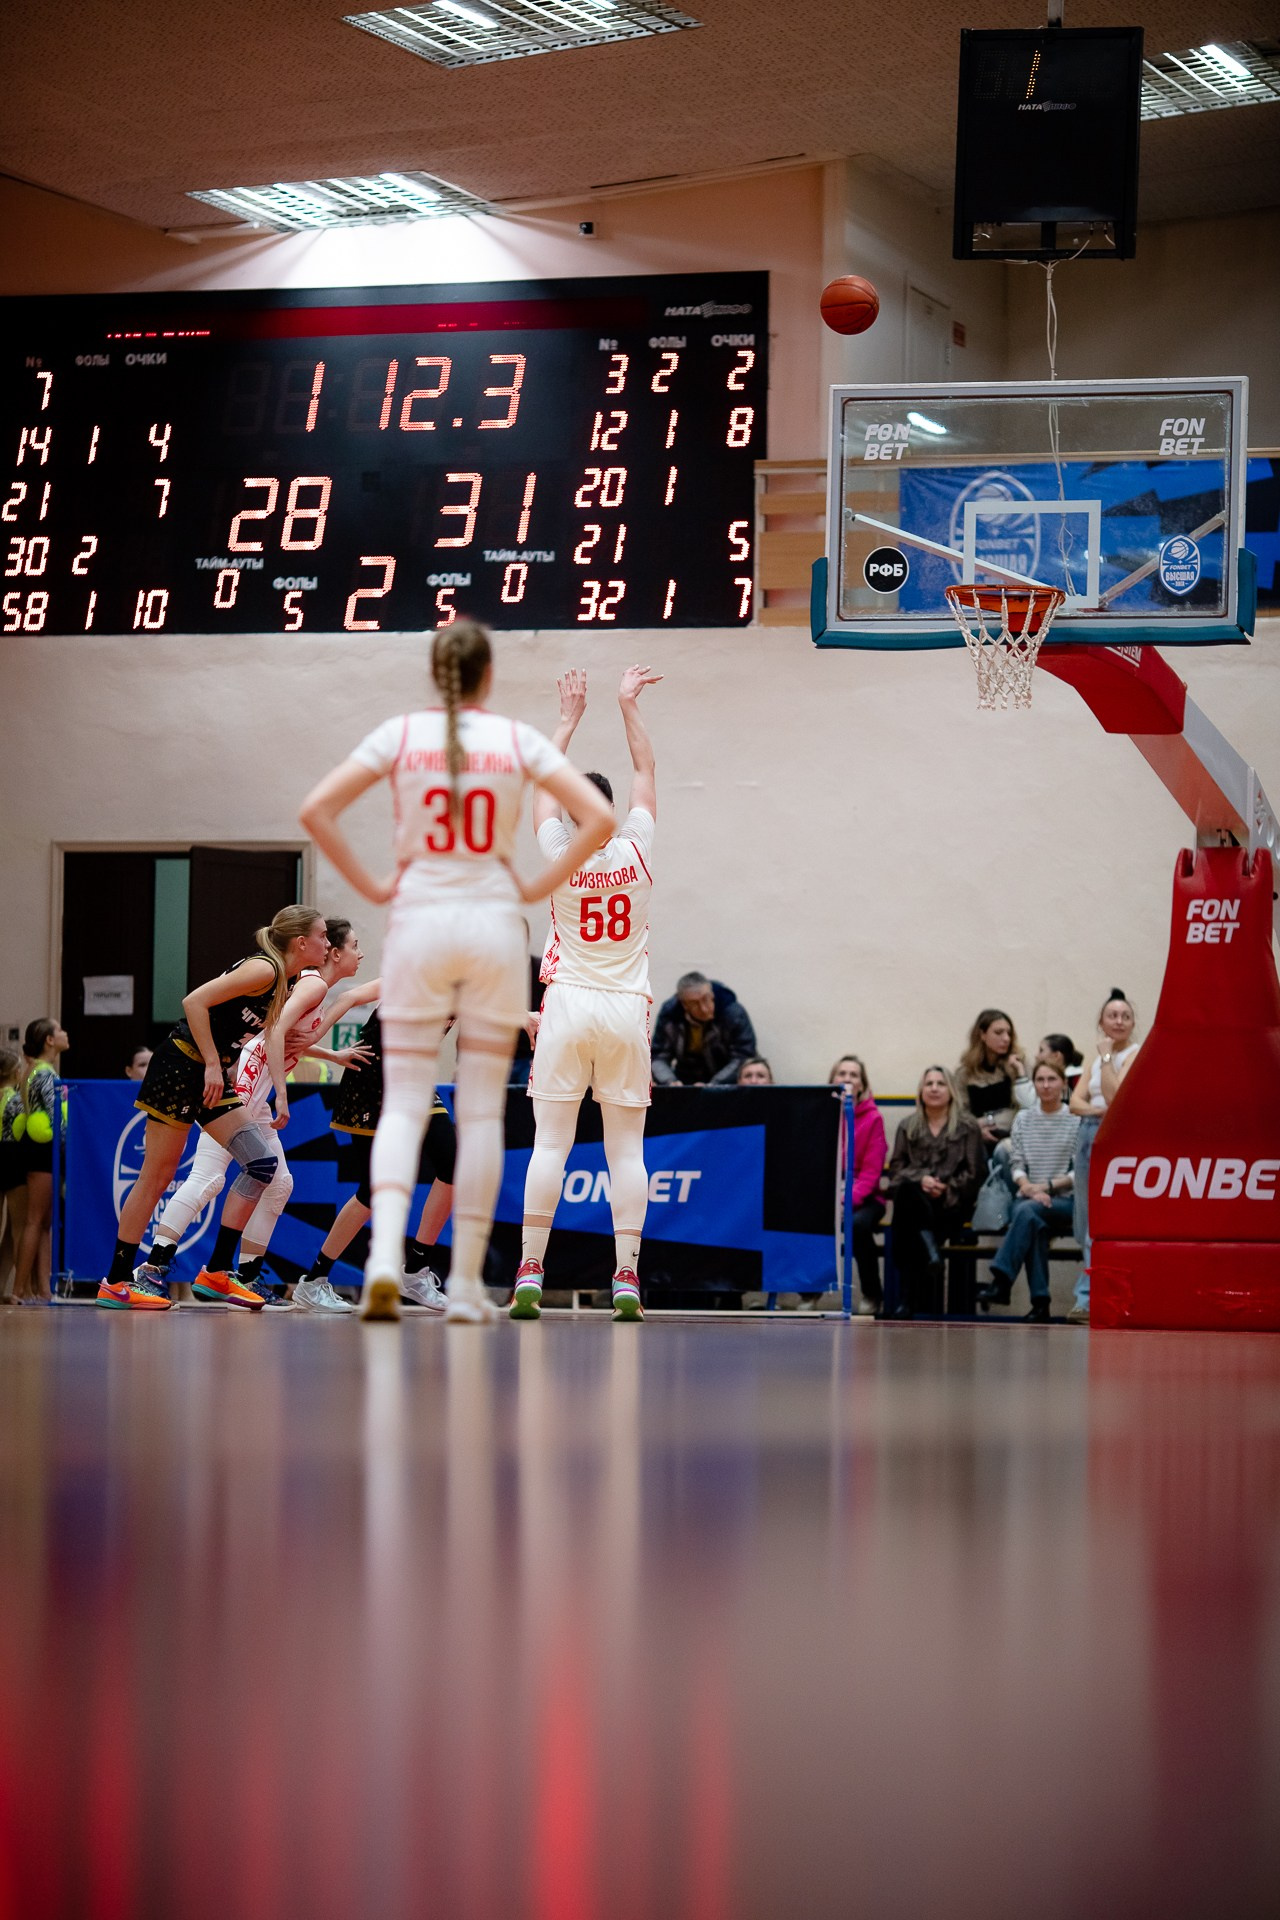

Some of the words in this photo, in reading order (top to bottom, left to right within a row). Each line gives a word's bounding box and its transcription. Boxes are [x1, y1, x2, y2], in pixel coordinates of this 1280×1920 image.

[75, 354, 110, 366] ФОЛЫ
[125, 352, 167, 365] ОЧКИ
[649, 336, 686, 348] ФОЛЫ
[711, 334, 755, 347] ОЧКИ
[36, 371, 53, 411] 7
[378, 353, 527, 432] 12.3
[605, 354, 630, 394] 3
[650, 352, 680, 393] 2
[727, 350, 756, 391] 2
[305, 361, 326, 433] 1
[16, 426, 53, 467] 14
[87, 425, 101, 465] 1
[148, 423, 172, 463] 4
[589, 410, 629, 452] 12
[665, 409, 679, 449] 1
[725, 406, 755, 448] 8
[864, 423, 911, 441] FON
[1158, 437, 1206, 456] BET
[1159, 417, 1206, 436] FON
[863, 442, 909, 460] BET
[1, 481, 51, 522] 21
[154, 478, 172, 518] 7
[573, 467, 628, 509] 20
[664, 465, 678, 506] 1
[227, 475, 333, 553] 28
[433, 471, 537, 548] 31
[4, 536, 51, 577] 30
[71, 535, 99, 576] 2
[483, 550, 555, 563] ТАЙМ-АУТЫ
[572, 523, 627, 565] 21
[727, 520, 751, 562] 5
[195, 557, 264, 570] ТАЙМ-АУТЫ
[273, 576, 318, 590] ФОЛЫ
[426, 573, 471, 587] ФОЛЫ
[500, 562, 529, 604] 0
[869, 562, 904, 578] РФБ
[213, 567, 241, 609] 0
[343, 555, 397, 631] 2
[435, 588, 457, 628] 5
[576, 580, 627, 622] 32
[662, 579, 677, 620] 1
[733, 577, 753, 619] 7
[2, 591, 50, 632] 58
[84, 590, 98, 631] 1
[132, 588, 170, 630] 10
[282, 591, 304, 631] 5
[423, 787, 497, 854] 30
[568, 865, 639, 890] СИЗЯКОВА
[579, 893, 632, 943] 58
[1186, 899, 1241, 921] FON
[1186, 922, 1240, 944] BET
[562, 1169, 702, 1203] ONET
